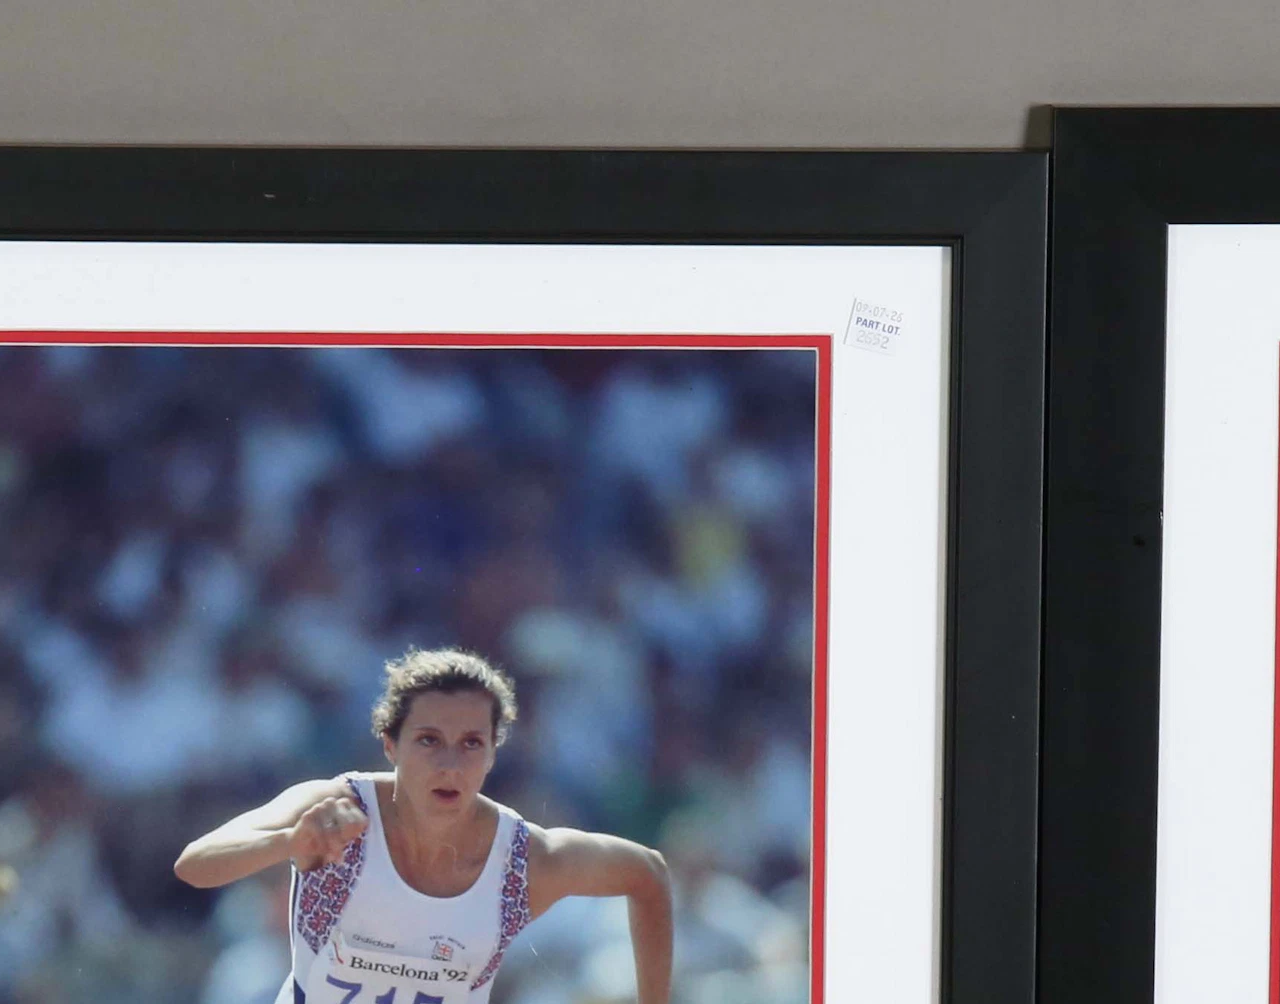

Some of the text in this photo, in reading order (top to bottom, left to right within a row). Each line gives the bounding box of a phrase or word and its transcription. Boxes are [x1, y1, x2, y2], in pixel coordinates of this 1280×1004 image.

[855, 316, 882, 330] PART
[348, 956, 439, 981] Barcelona
[442, 968, 468, 982] '92
